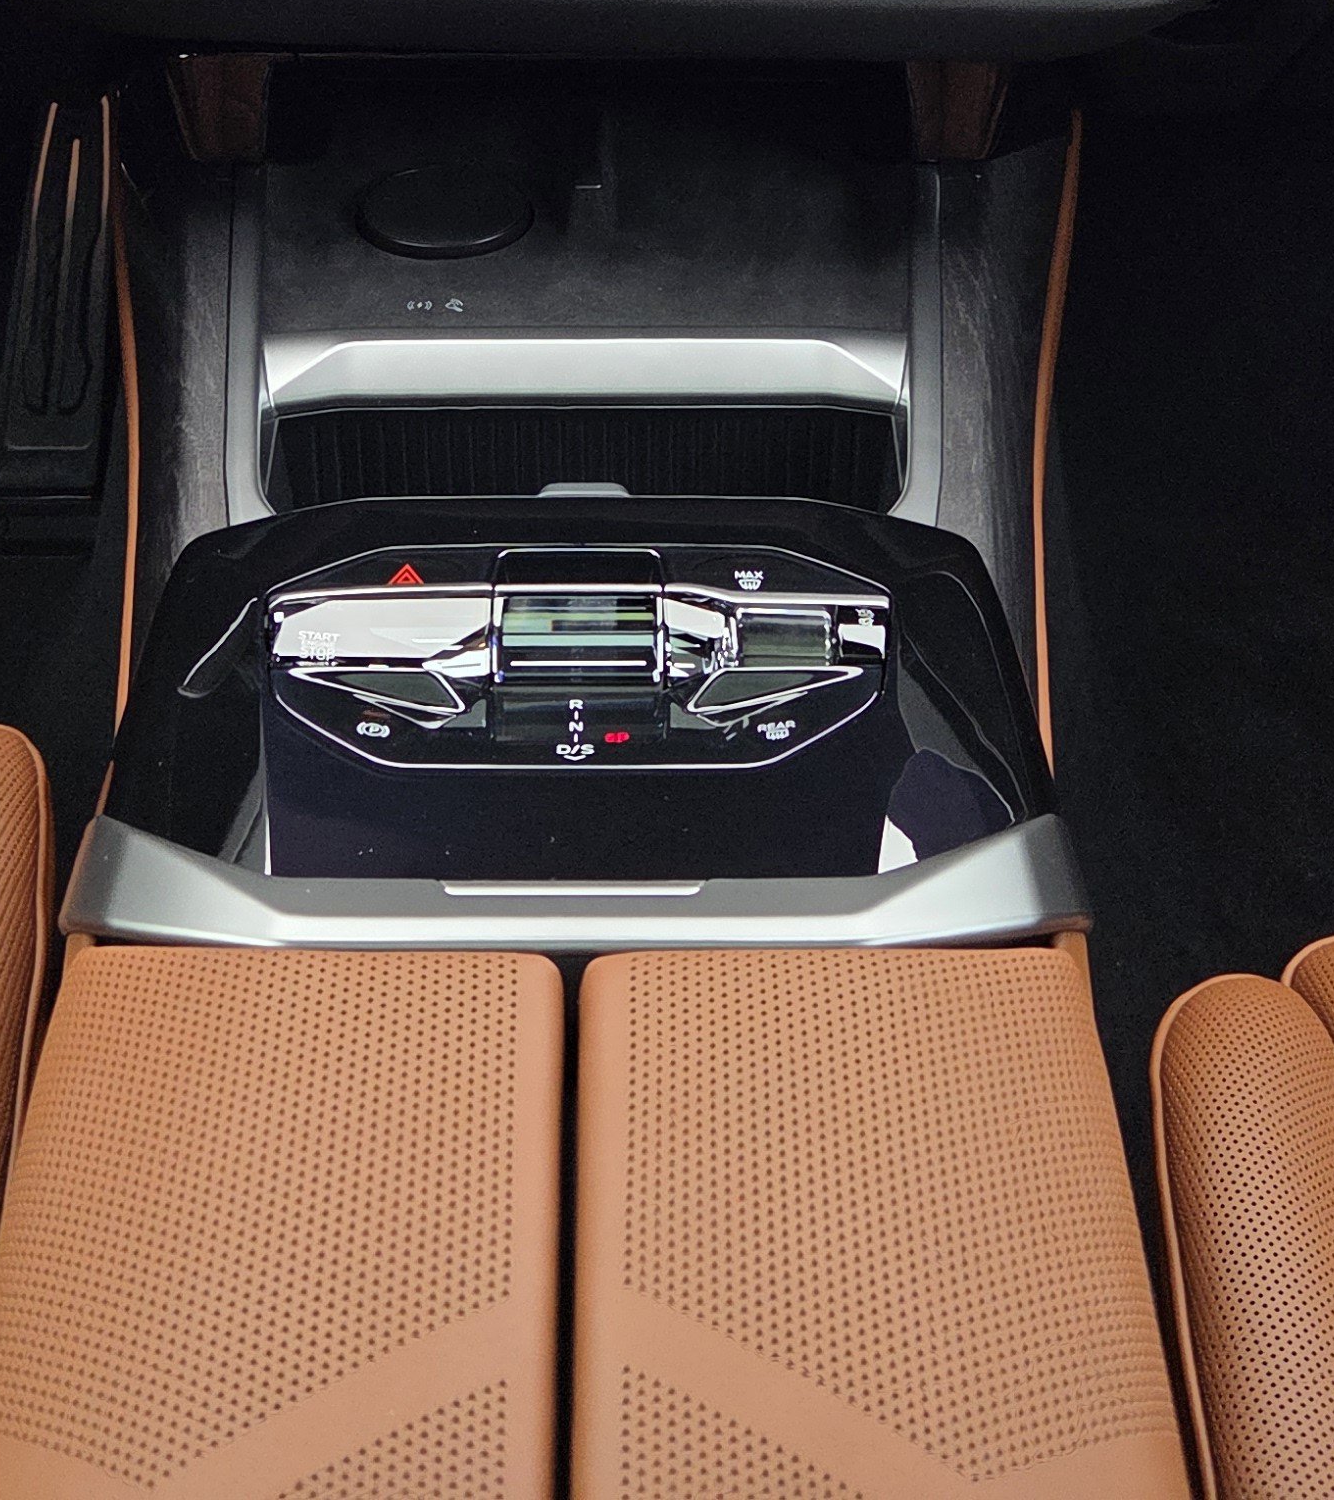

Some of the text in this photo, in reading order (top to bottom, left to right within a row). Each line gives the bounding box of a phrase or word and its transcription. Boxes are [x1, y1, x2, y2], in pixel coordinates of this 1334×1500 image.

[734, 570, 764, 580] MAX
[298, 630, 341, 643] START
[299, 645, 336, 661] STOP
